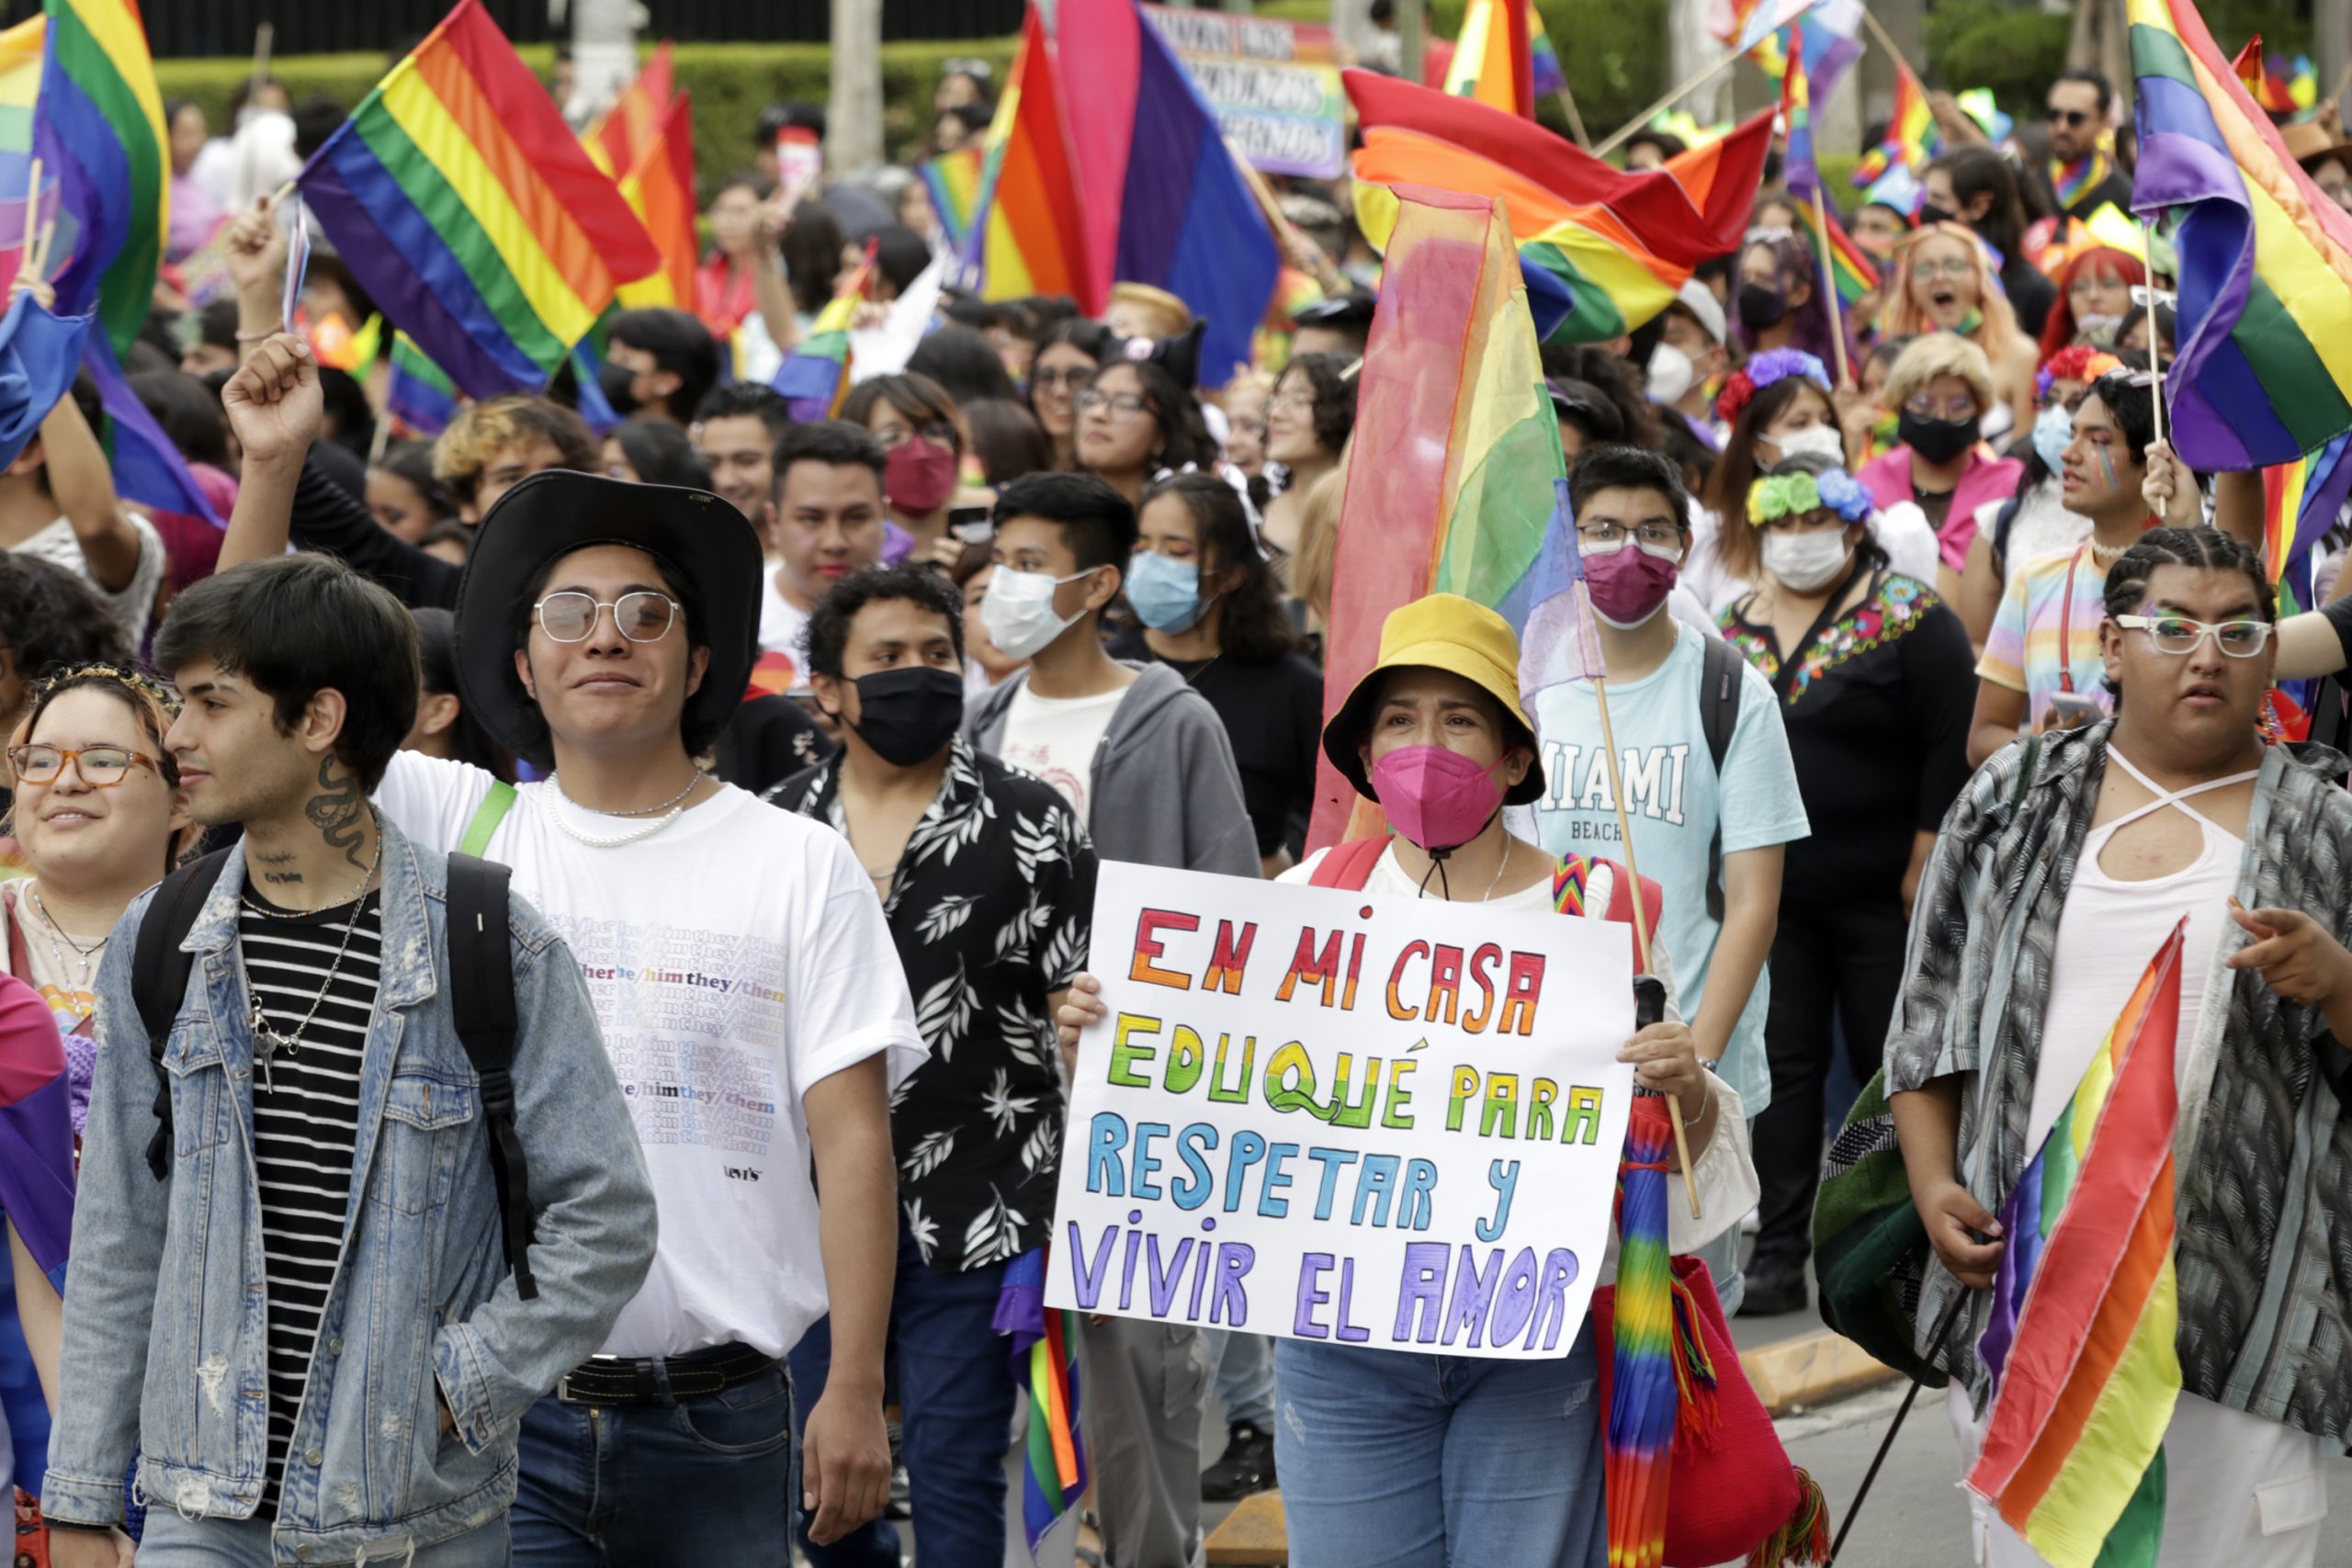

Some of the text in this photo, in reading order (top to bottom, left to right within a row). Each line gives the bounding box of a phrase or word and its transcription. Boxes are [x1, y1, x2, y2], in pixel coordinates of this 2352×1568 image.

[1571, 820, 1623, 841] BEACH
[581, 964, 615, 980] her
[1128, 905, 1546, 1036] EN MI CASA
[1107, 1011, 1604, 1145] EDUQUÉ PARA
[1085, 1111, 1440, 1231] RESPETAR
[1067, 1210, 1580, 1351] VIVIR EL AMOR
